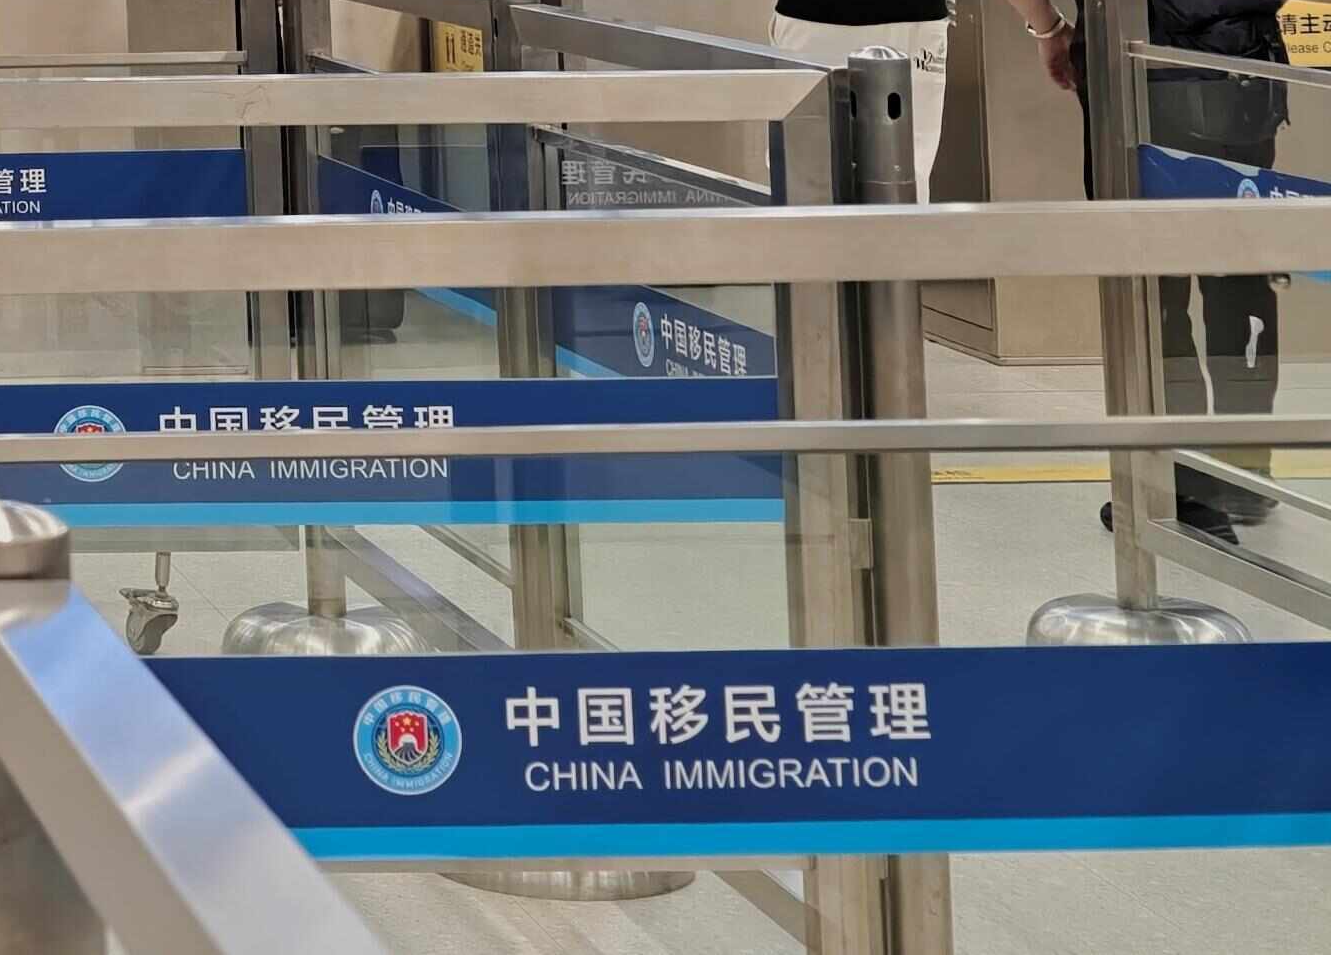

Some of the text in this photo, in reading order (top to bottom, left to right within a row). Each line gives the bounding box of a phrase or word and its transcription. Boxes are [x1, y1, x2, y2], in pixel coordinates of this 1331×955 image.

[660, 312, 748, 377] 中国移民管理
[158, 403, 455, 433] 中国移民管理
[172, 457, 449, 481] CHINA IMMIGRATION
[504, 682, 932, 747] 中国移民管理
[524, 755, 920, 793] CHINA IMMIGRATION
